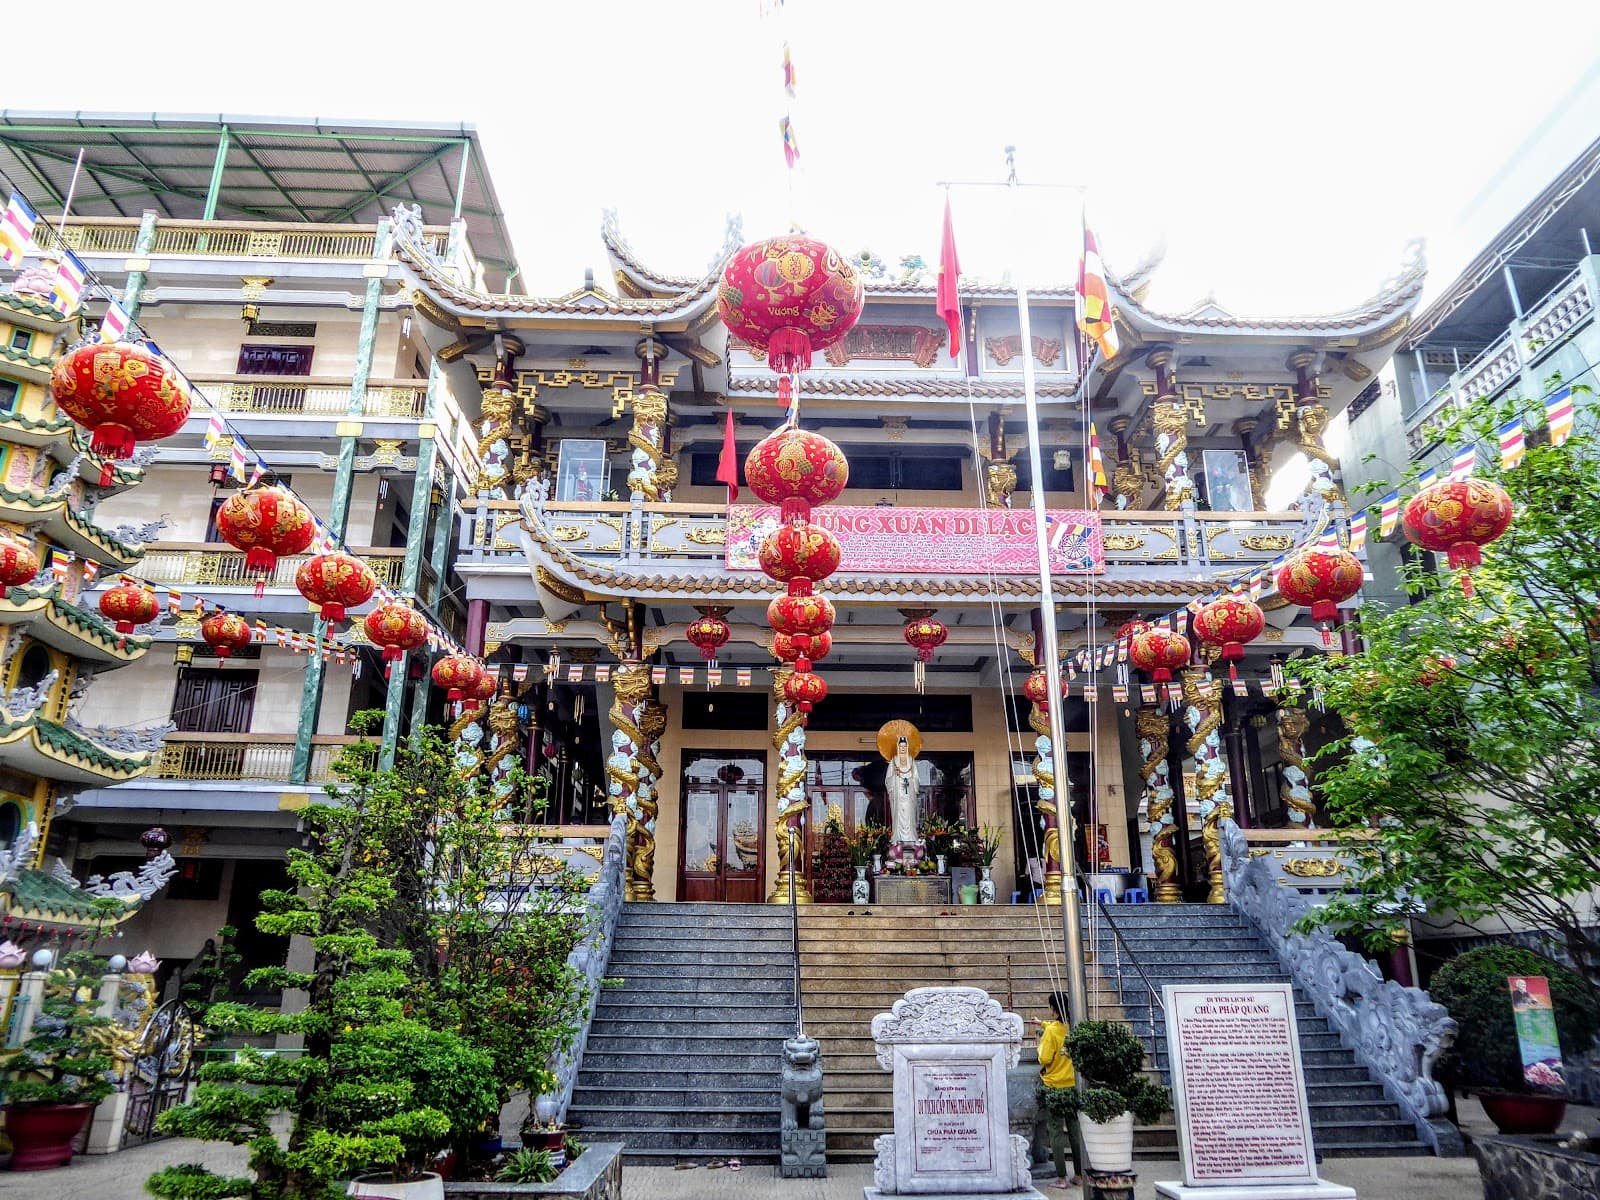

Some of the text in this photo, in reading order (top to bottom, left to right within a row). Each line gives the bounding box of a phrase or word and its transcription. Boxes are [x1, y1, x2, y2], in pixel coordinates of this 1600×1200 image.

[810, 510, 1033, 541] ỪNG XUÂN DI LẶC
[1194, 1003, 1270, 1016] CHÙA PHÁP QUANG
